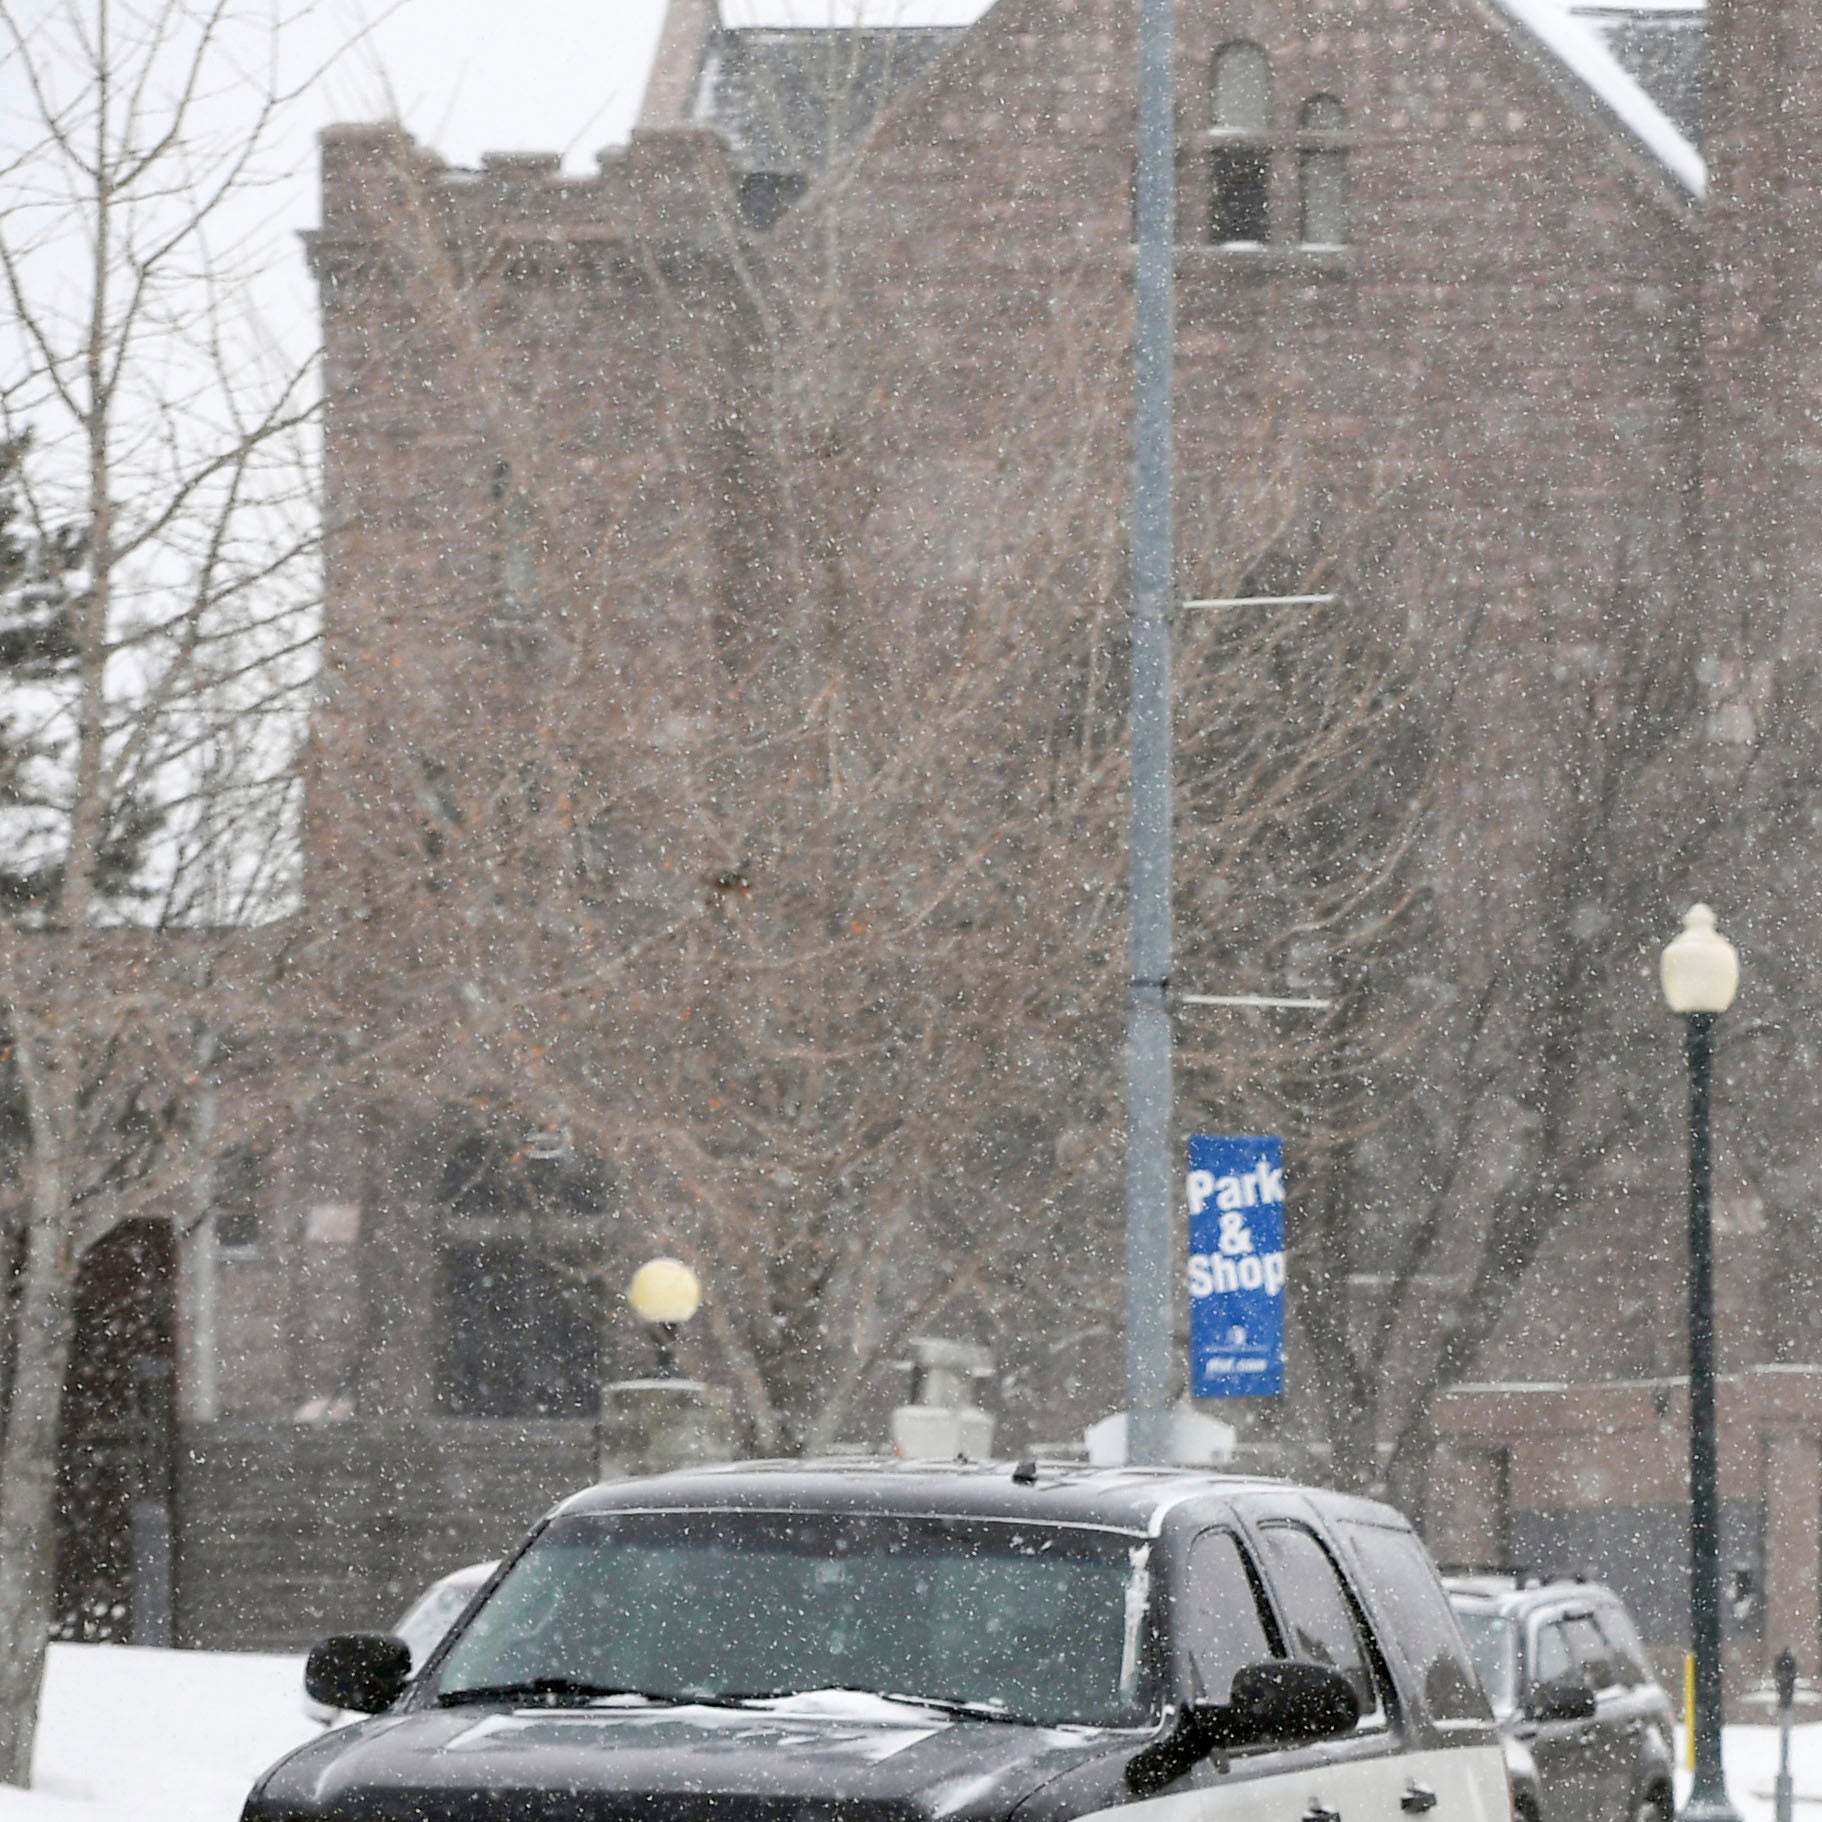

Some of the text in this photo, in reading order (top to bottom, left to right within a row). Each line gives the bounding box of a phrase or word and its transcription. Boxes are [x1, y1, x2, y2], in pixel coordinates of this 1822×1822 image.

[1186, 1160, 1286, 1215] Park
[1219, 1211, 1254, 1255] &
[1187, 1252, 1287, 1298] Shop
